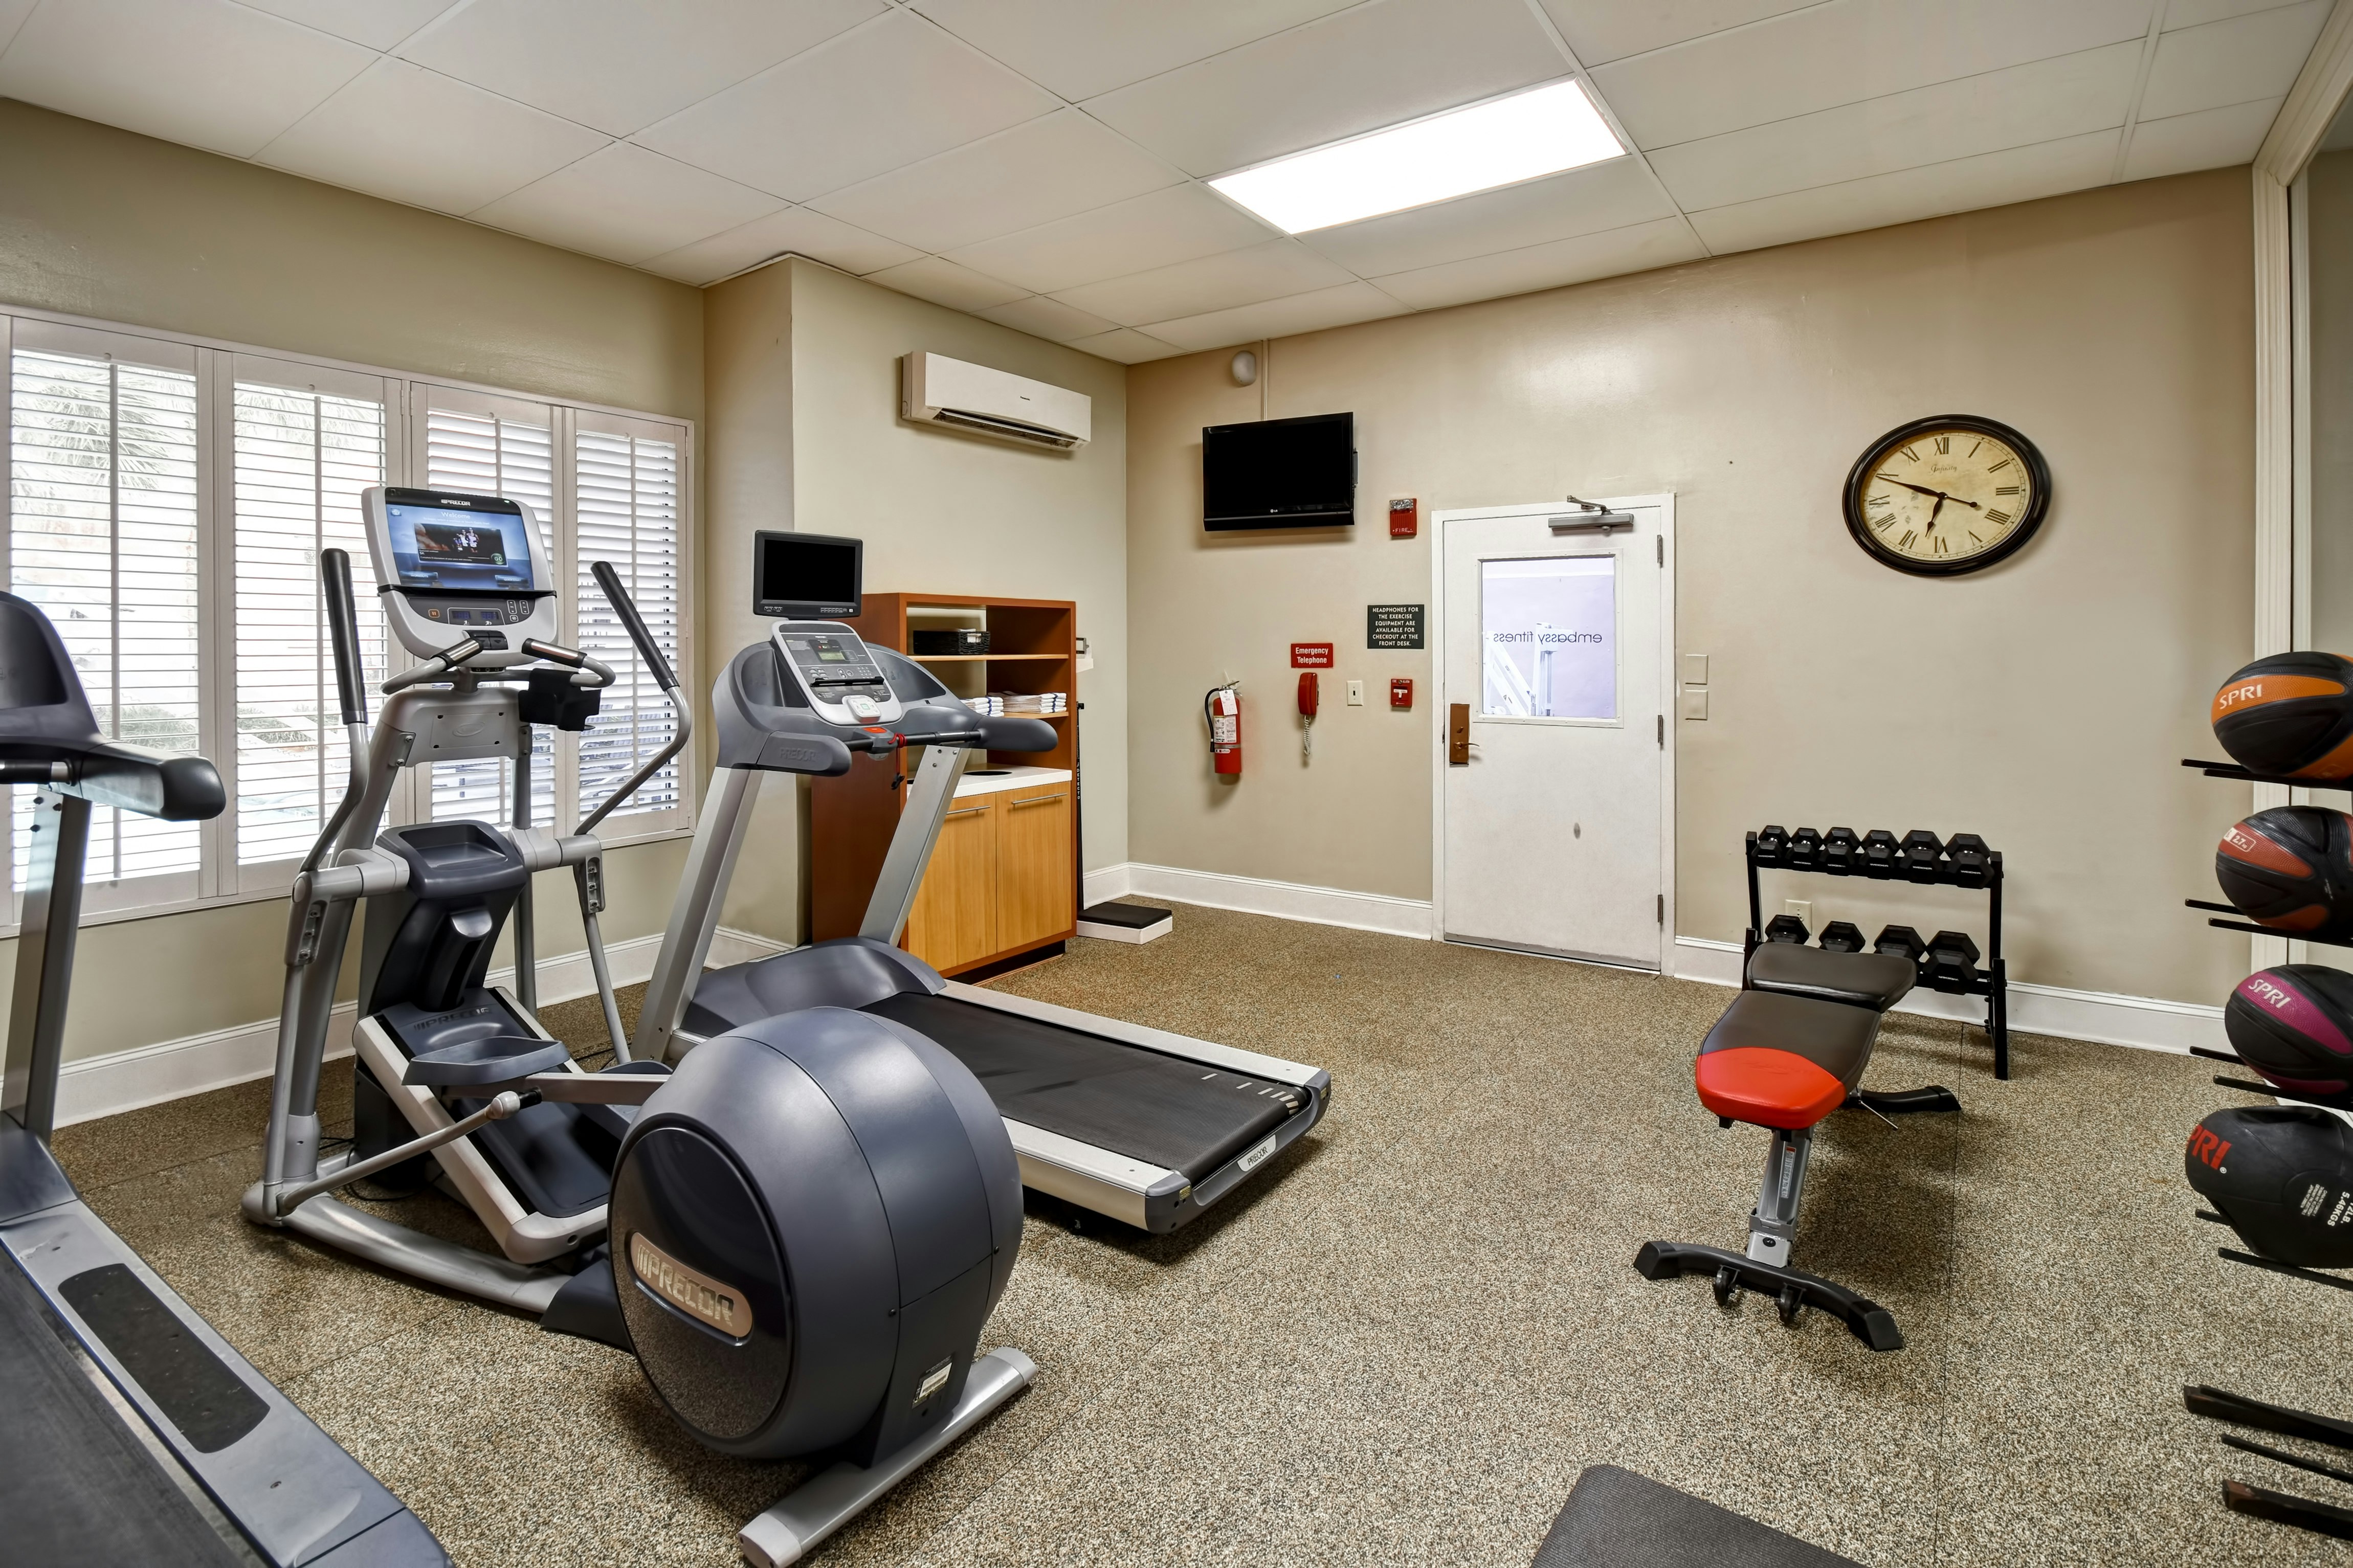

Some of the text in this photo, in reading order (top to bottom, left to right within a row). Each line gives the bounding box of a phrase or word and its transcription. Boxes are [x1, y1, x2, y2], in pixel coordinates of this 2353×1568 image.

[1934, 437, 1949, 456] XII
[1968, 441, 1982, 458] I
[1987, 459, 2011, 474] II
[1995, 486, 2019, 496] III
[1295, 647, 1328, 656] Emergency
[1297, 657, 1327, 665] Telephone
[2219, 684, 2262, 709] SPRI
[2248, 979, 2291, 1008] SPRI
[1247, 1146, 1268, 1166] PRECOR
[2188, 1124, 2232, 1170] PRI
[2327, 1192, 2350, 1226] 5.46KGS
[647, 1253, 734, 1327] PRECOR
